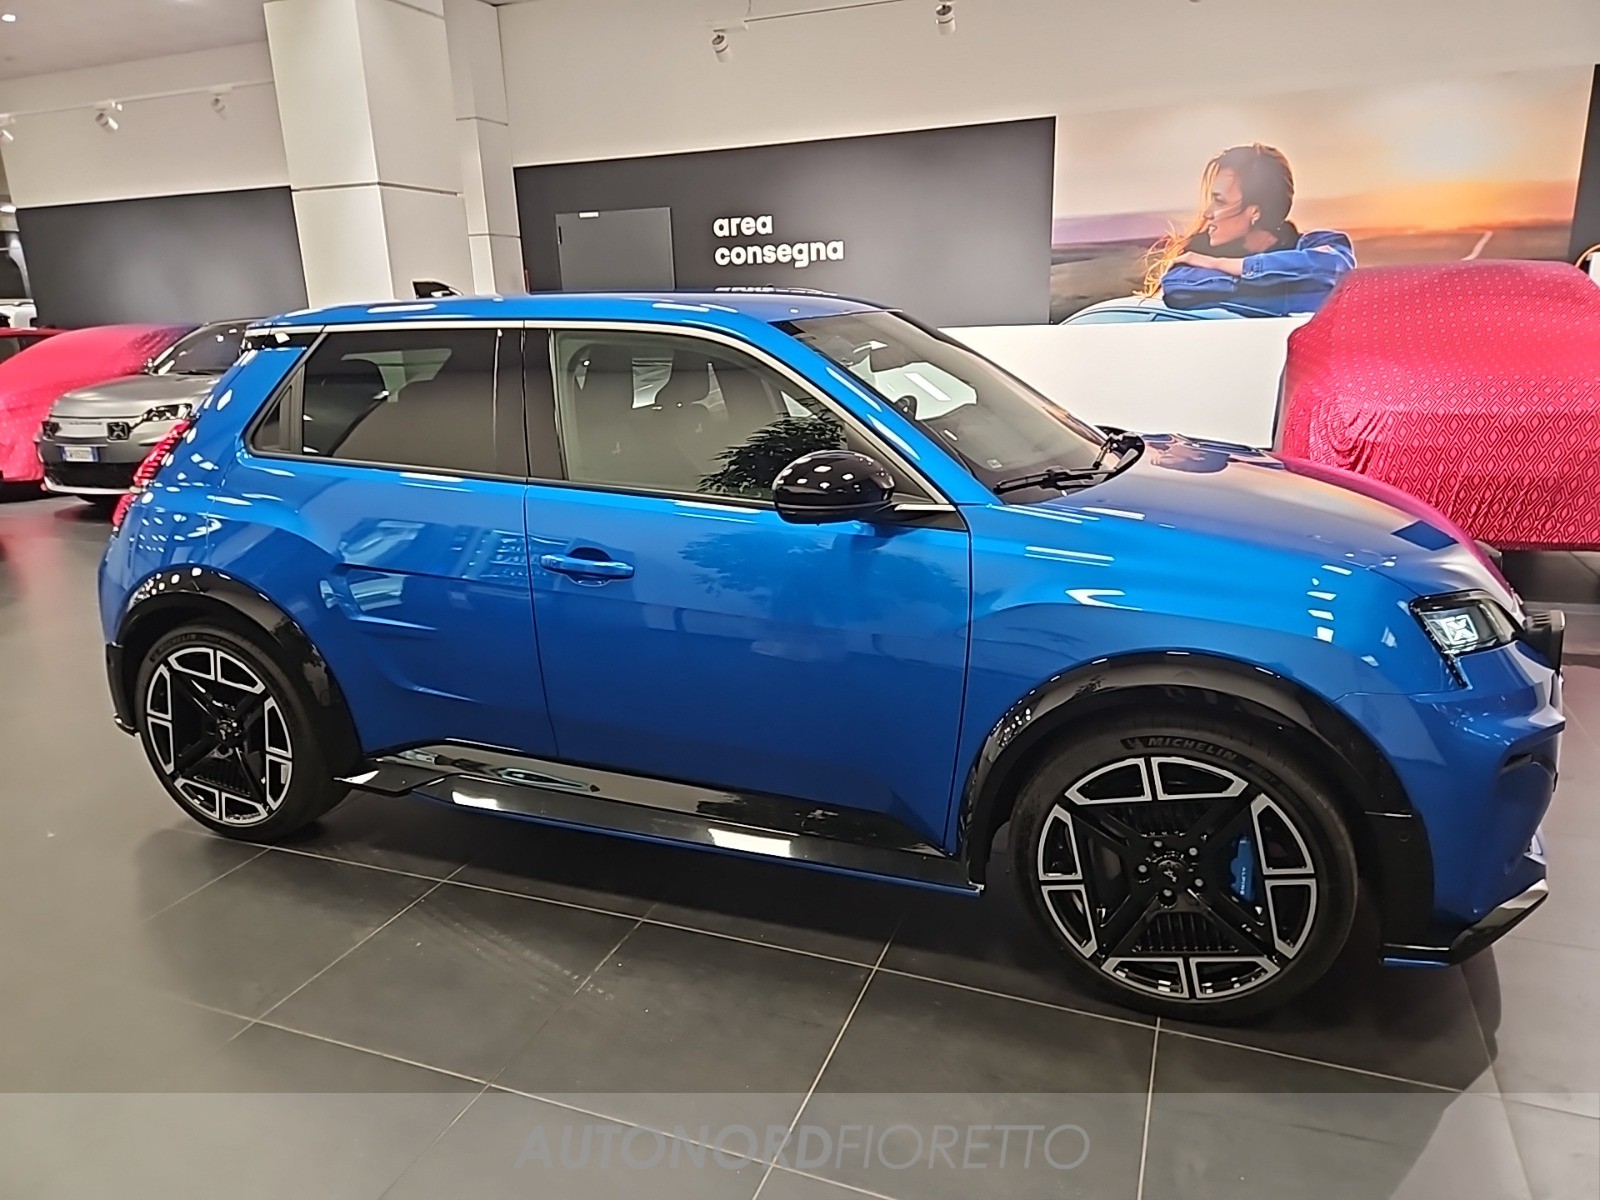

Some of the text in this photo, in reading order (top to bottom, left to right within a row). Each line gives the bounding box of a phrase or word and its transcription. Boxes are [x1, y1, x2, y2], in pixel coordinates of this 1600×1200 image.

[713, 215, 773, 237] area
[714, 240, 844, 268] consegna
[1149, 737, 1238, 761] MICHELIN
